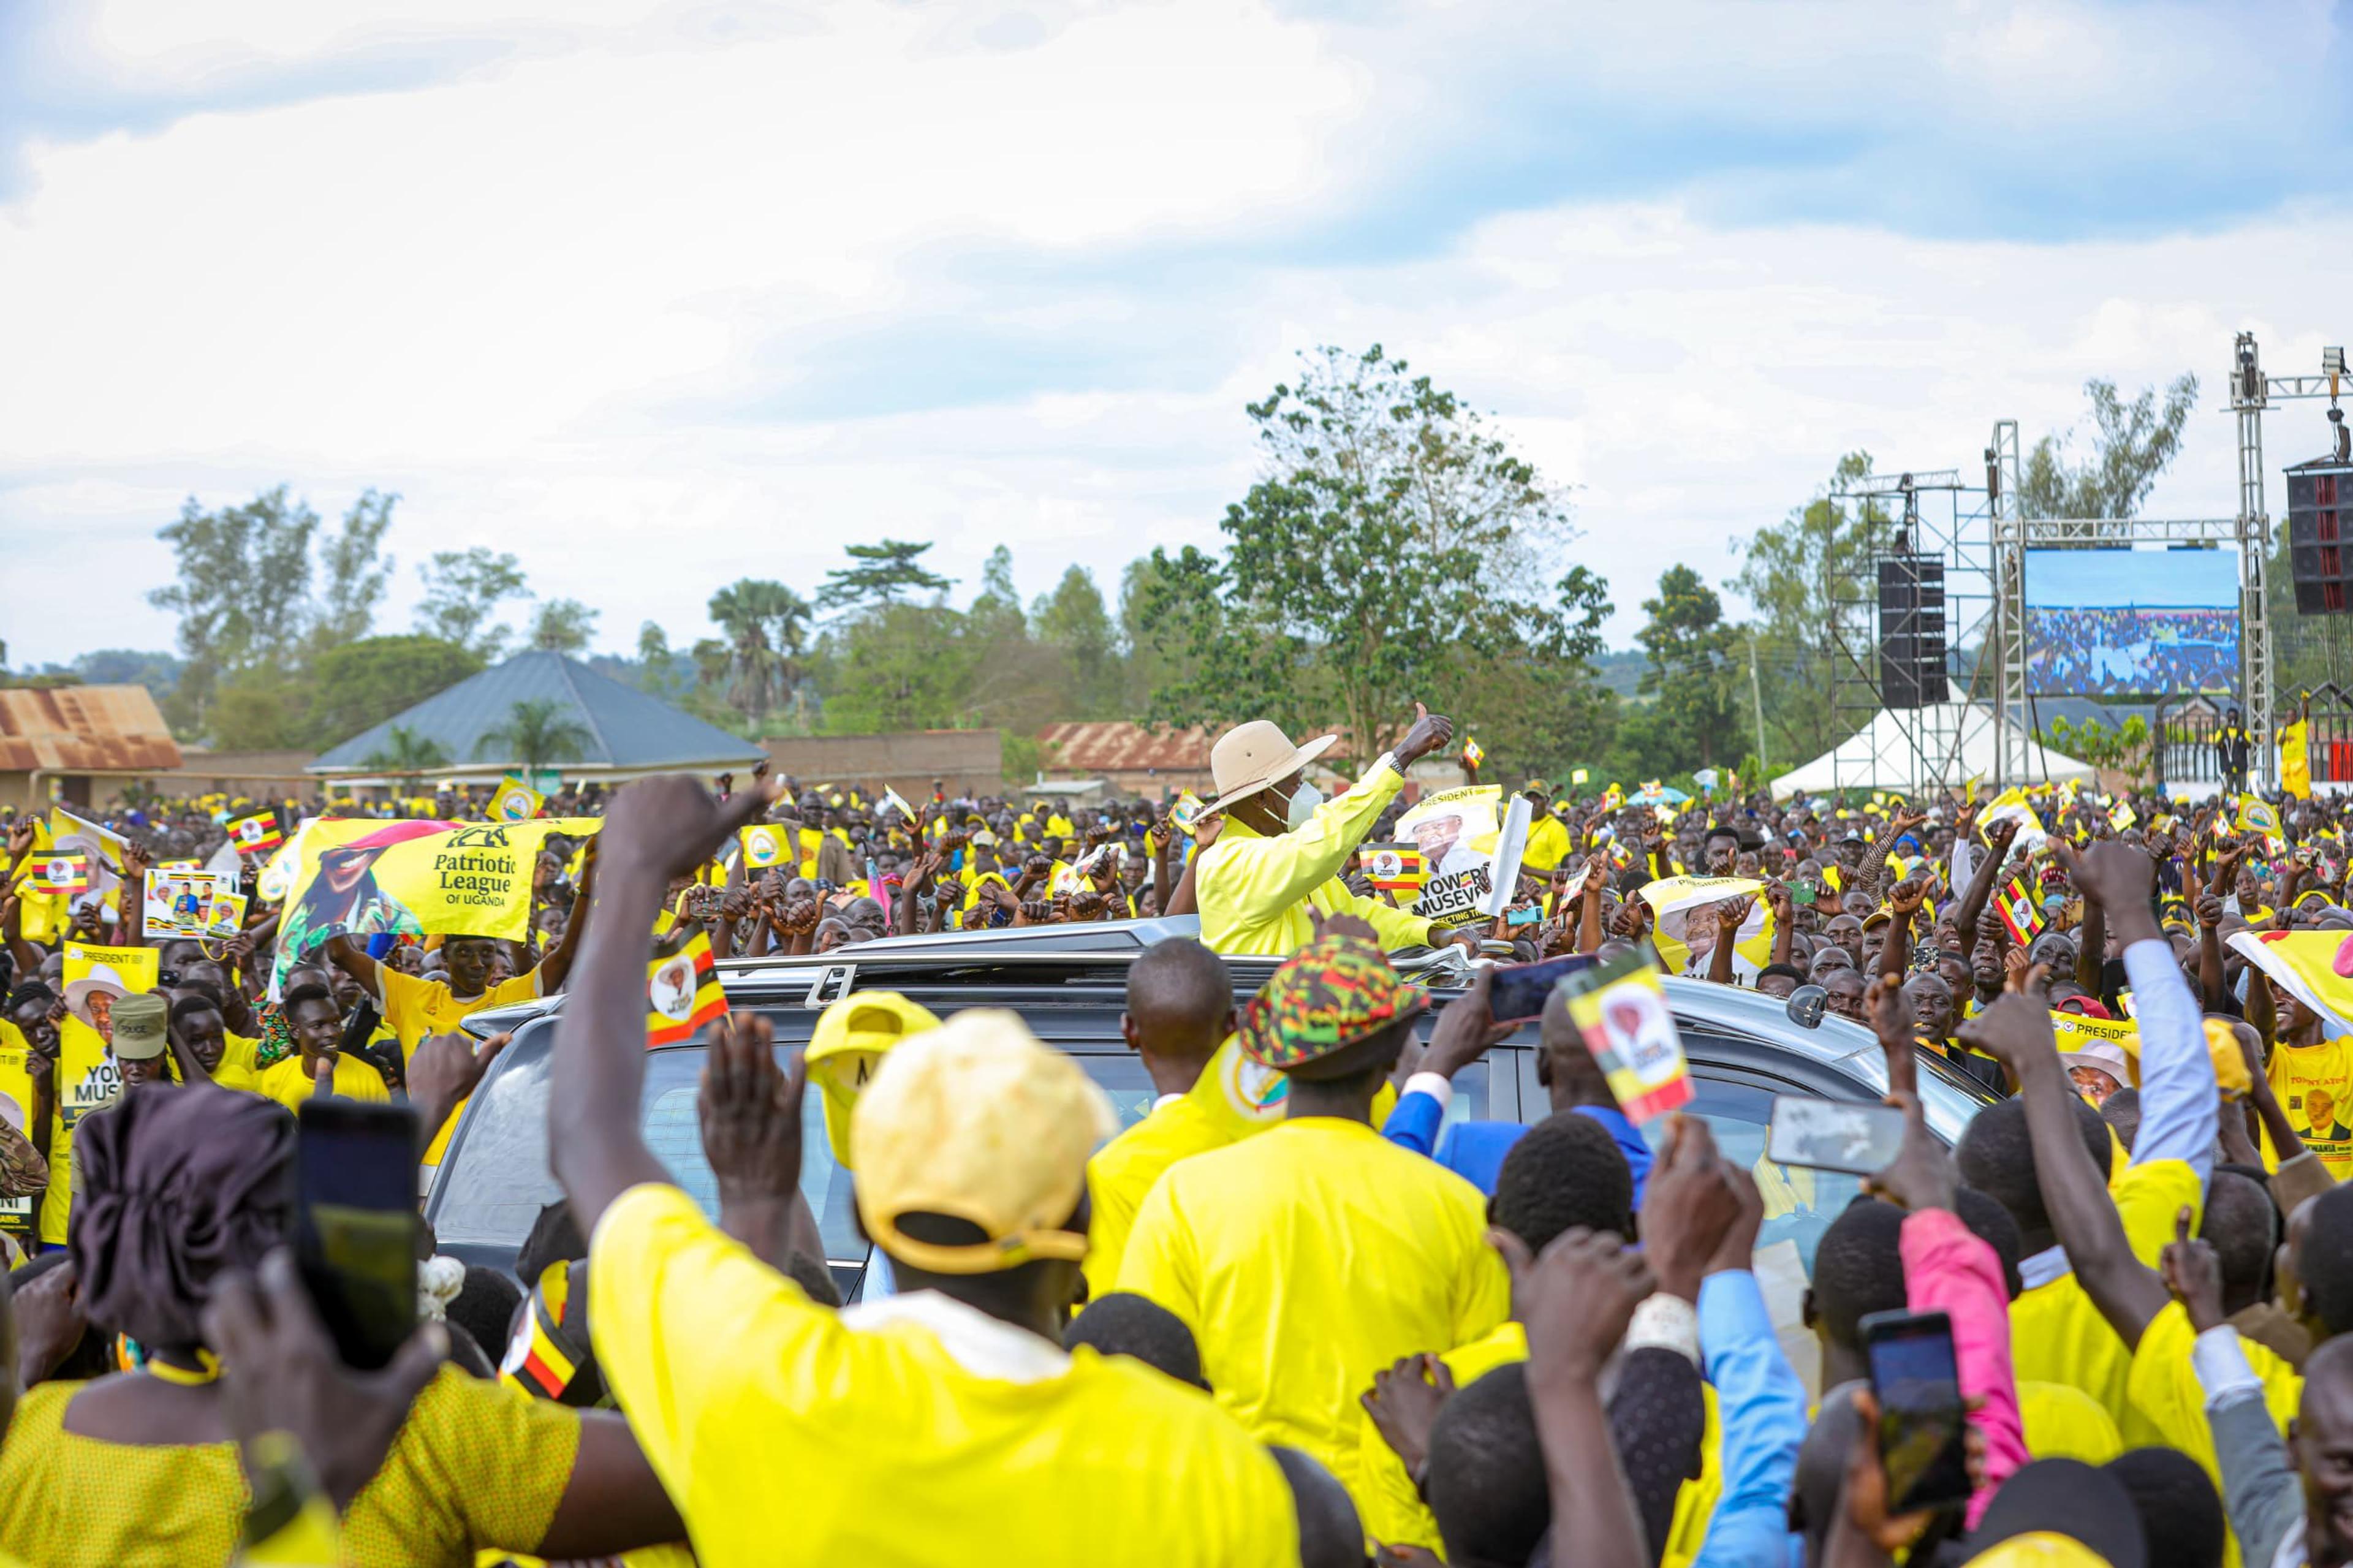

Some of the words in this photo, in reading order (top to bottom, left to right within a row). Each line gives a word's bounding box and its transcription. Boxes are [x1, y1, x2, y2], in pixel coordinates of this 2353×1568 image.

[1419, 787, 1474, 808] PRESIDENT
[434, 852, 516, 874] Patriotic
[439, 871, 511, 896] League
[1419, 868, 1483, 898] YOWER
[463, 895, 505, 906] UGANDA
[1411, 885, 1483, 916] MUSEV
[83, 950, 131, 964] PRESIDENT
[121, 1025, 148, 1034] POLICE
[2077, 1023, 2132, 1040] PRESIDE
